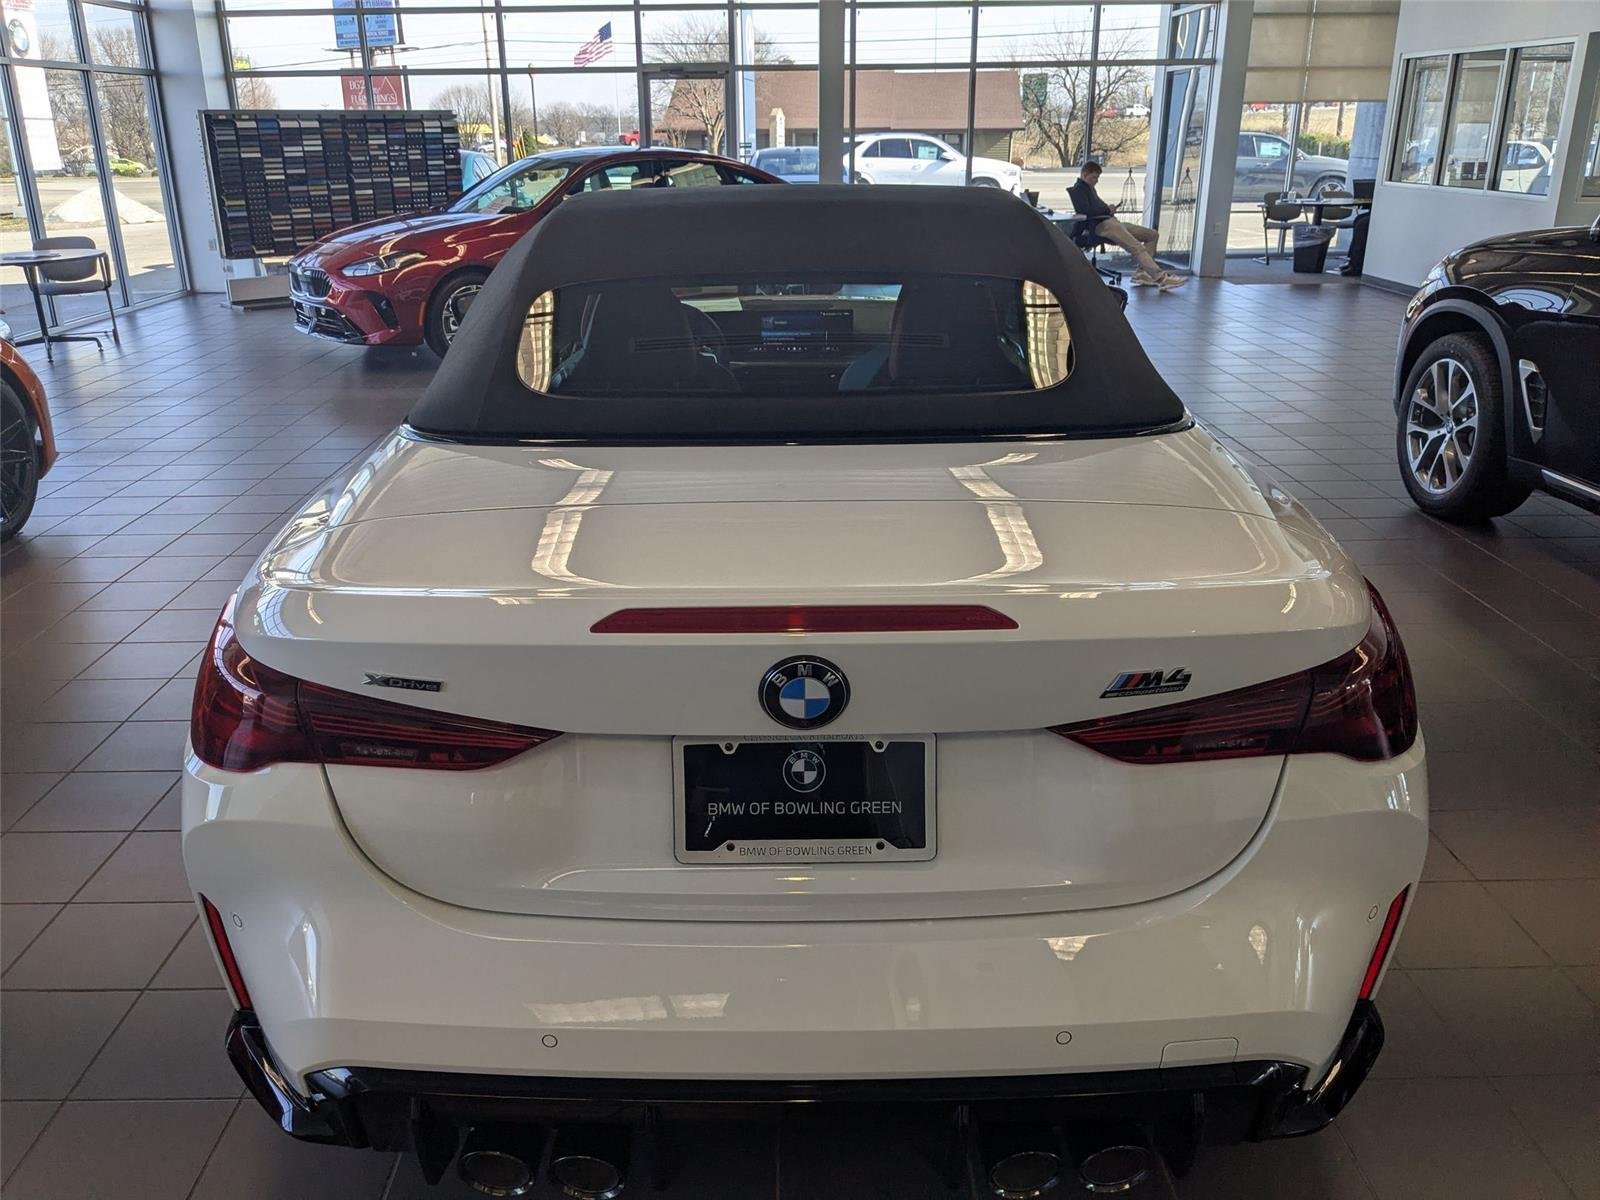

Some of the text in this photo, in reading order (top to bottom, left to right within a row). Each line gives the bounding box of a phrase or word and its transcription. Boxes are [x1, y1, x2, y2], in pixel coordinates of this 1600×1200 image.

[351, 94, 396, 104] FURNHINGS
[772, 664, 838, 688] BMW
[789, 752, 820, 764] BMW
[707, 801, 902, 816] BMW OF BOWLING GREEN
[739, 846, 872, 856] BMW OF BOWLING GREEN
